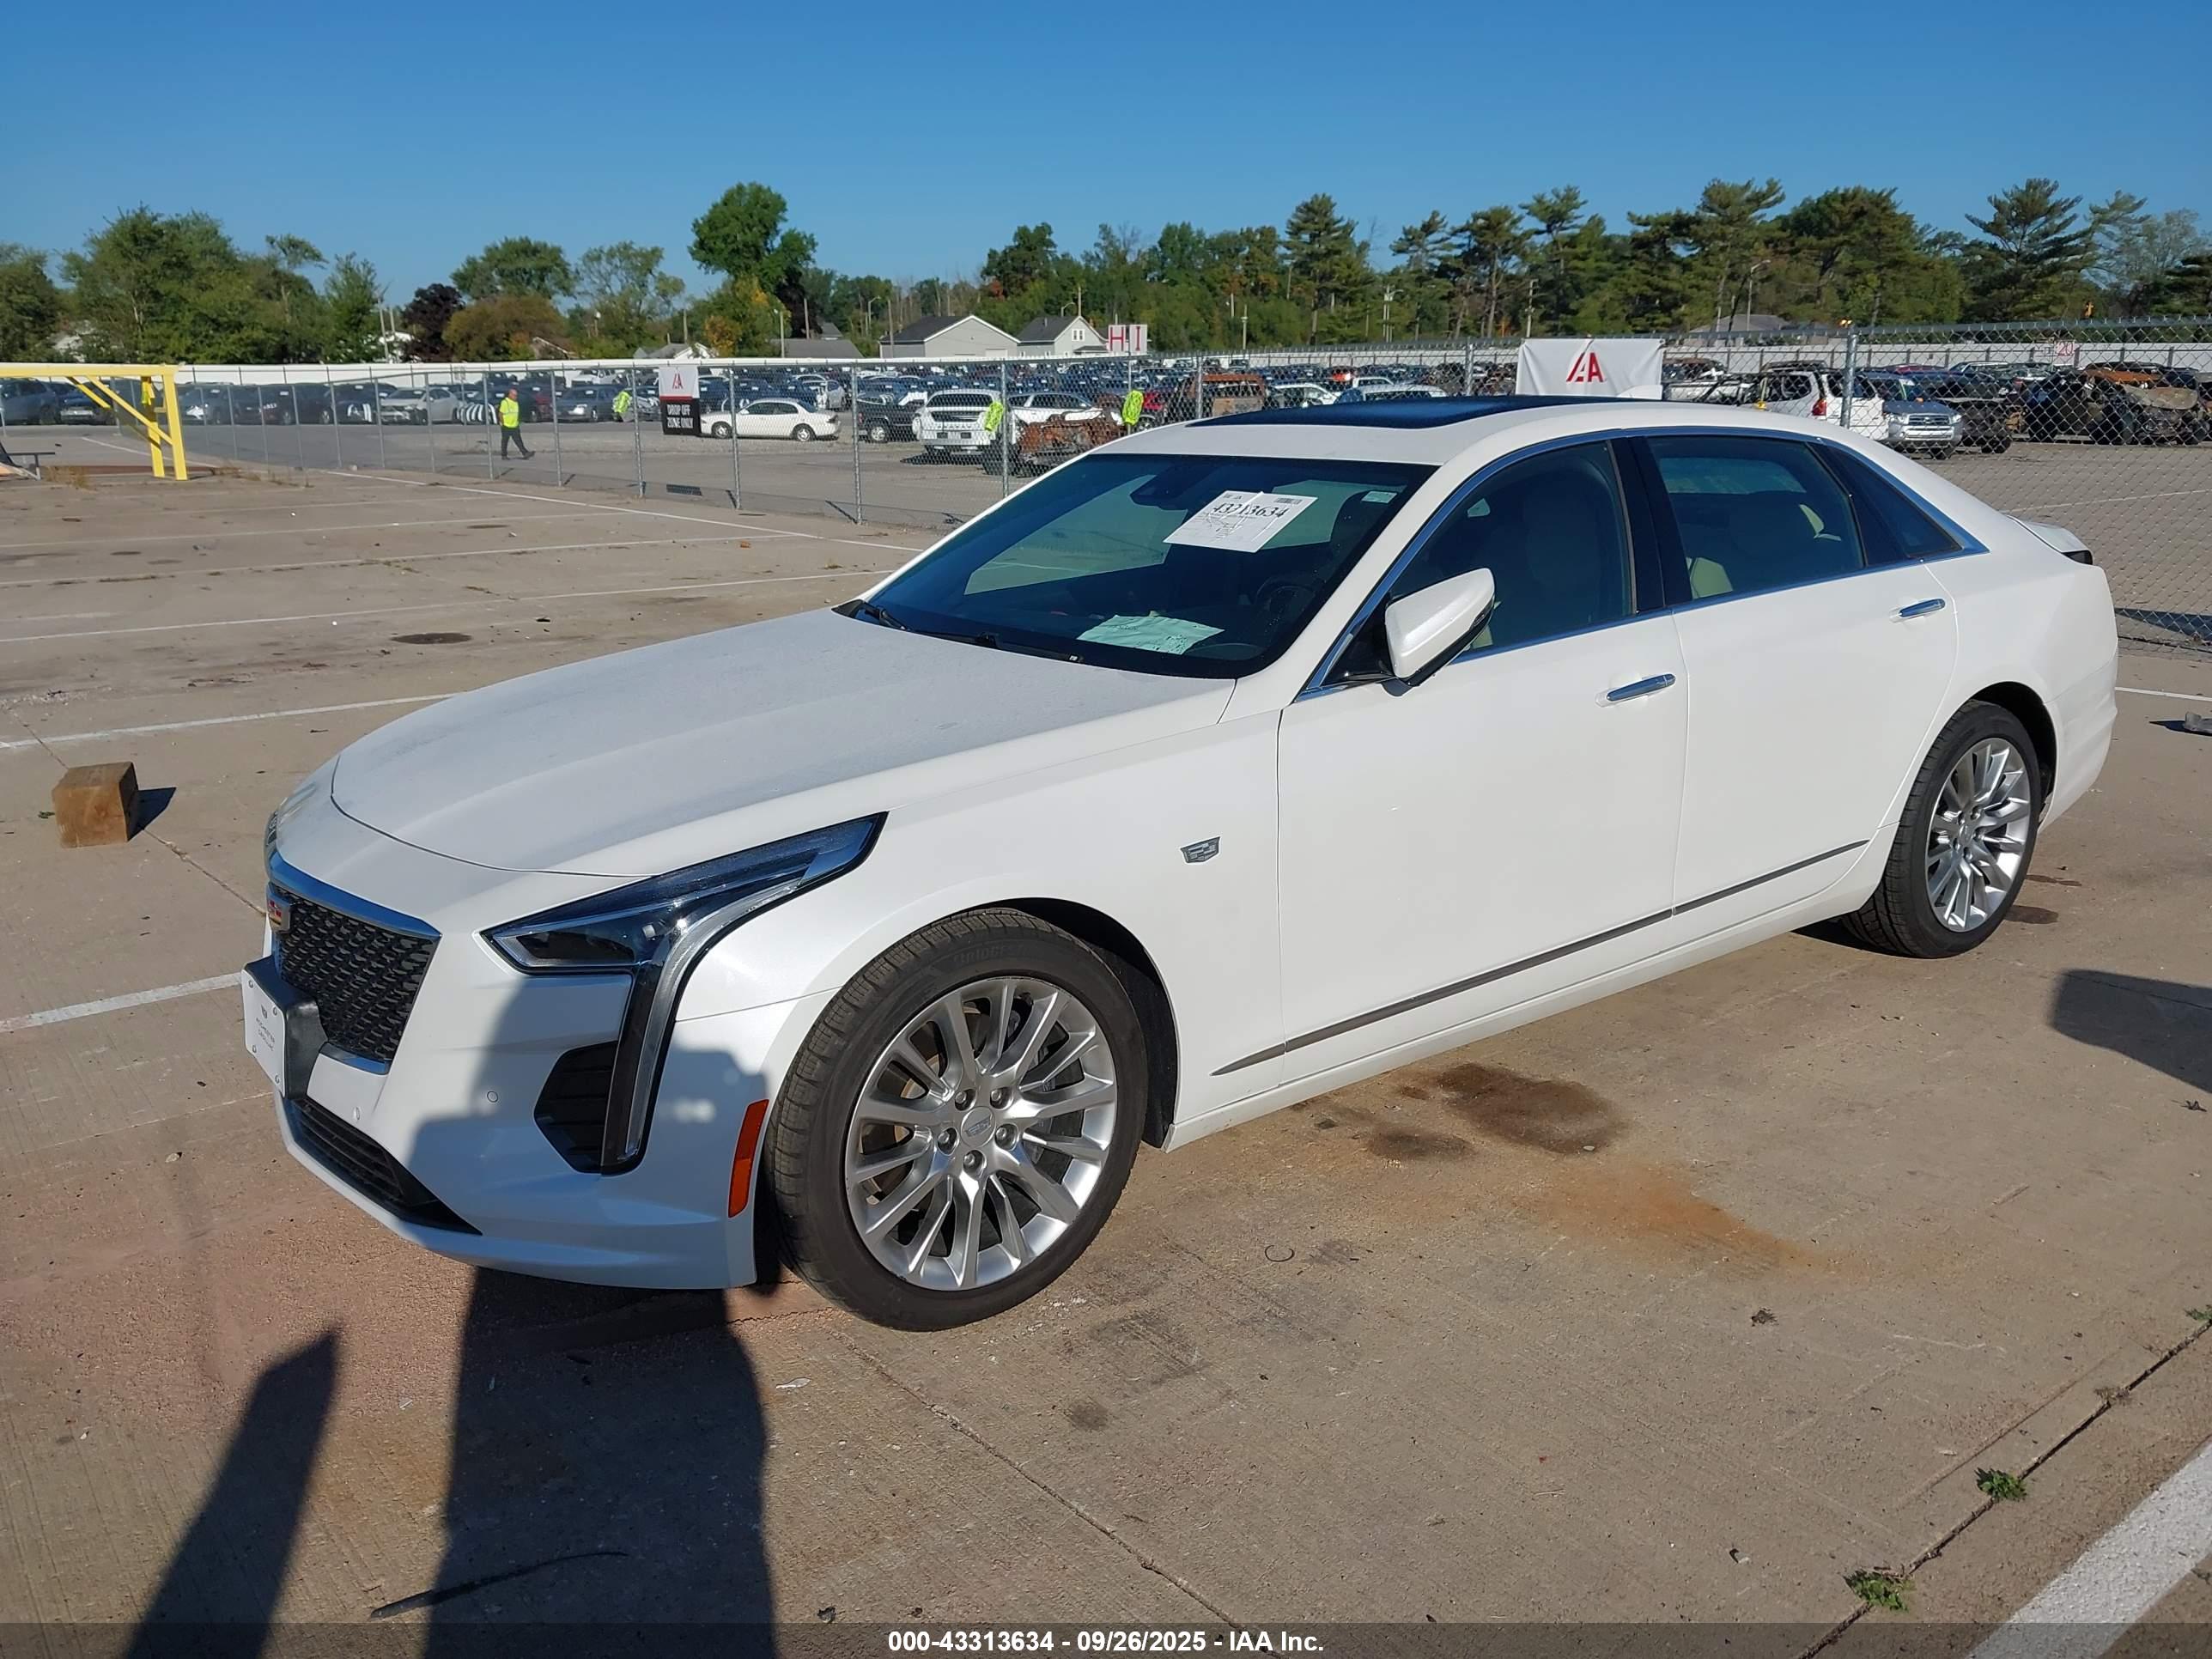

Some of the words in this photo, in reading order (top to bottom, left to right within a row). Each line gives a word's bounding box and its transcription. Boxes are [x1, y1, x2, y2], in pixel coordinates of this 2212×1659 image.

[666, 404, 681, 416] DROP
[681, 404, 691, 416] OFF
[680, 417, 694, 428] ONLY
